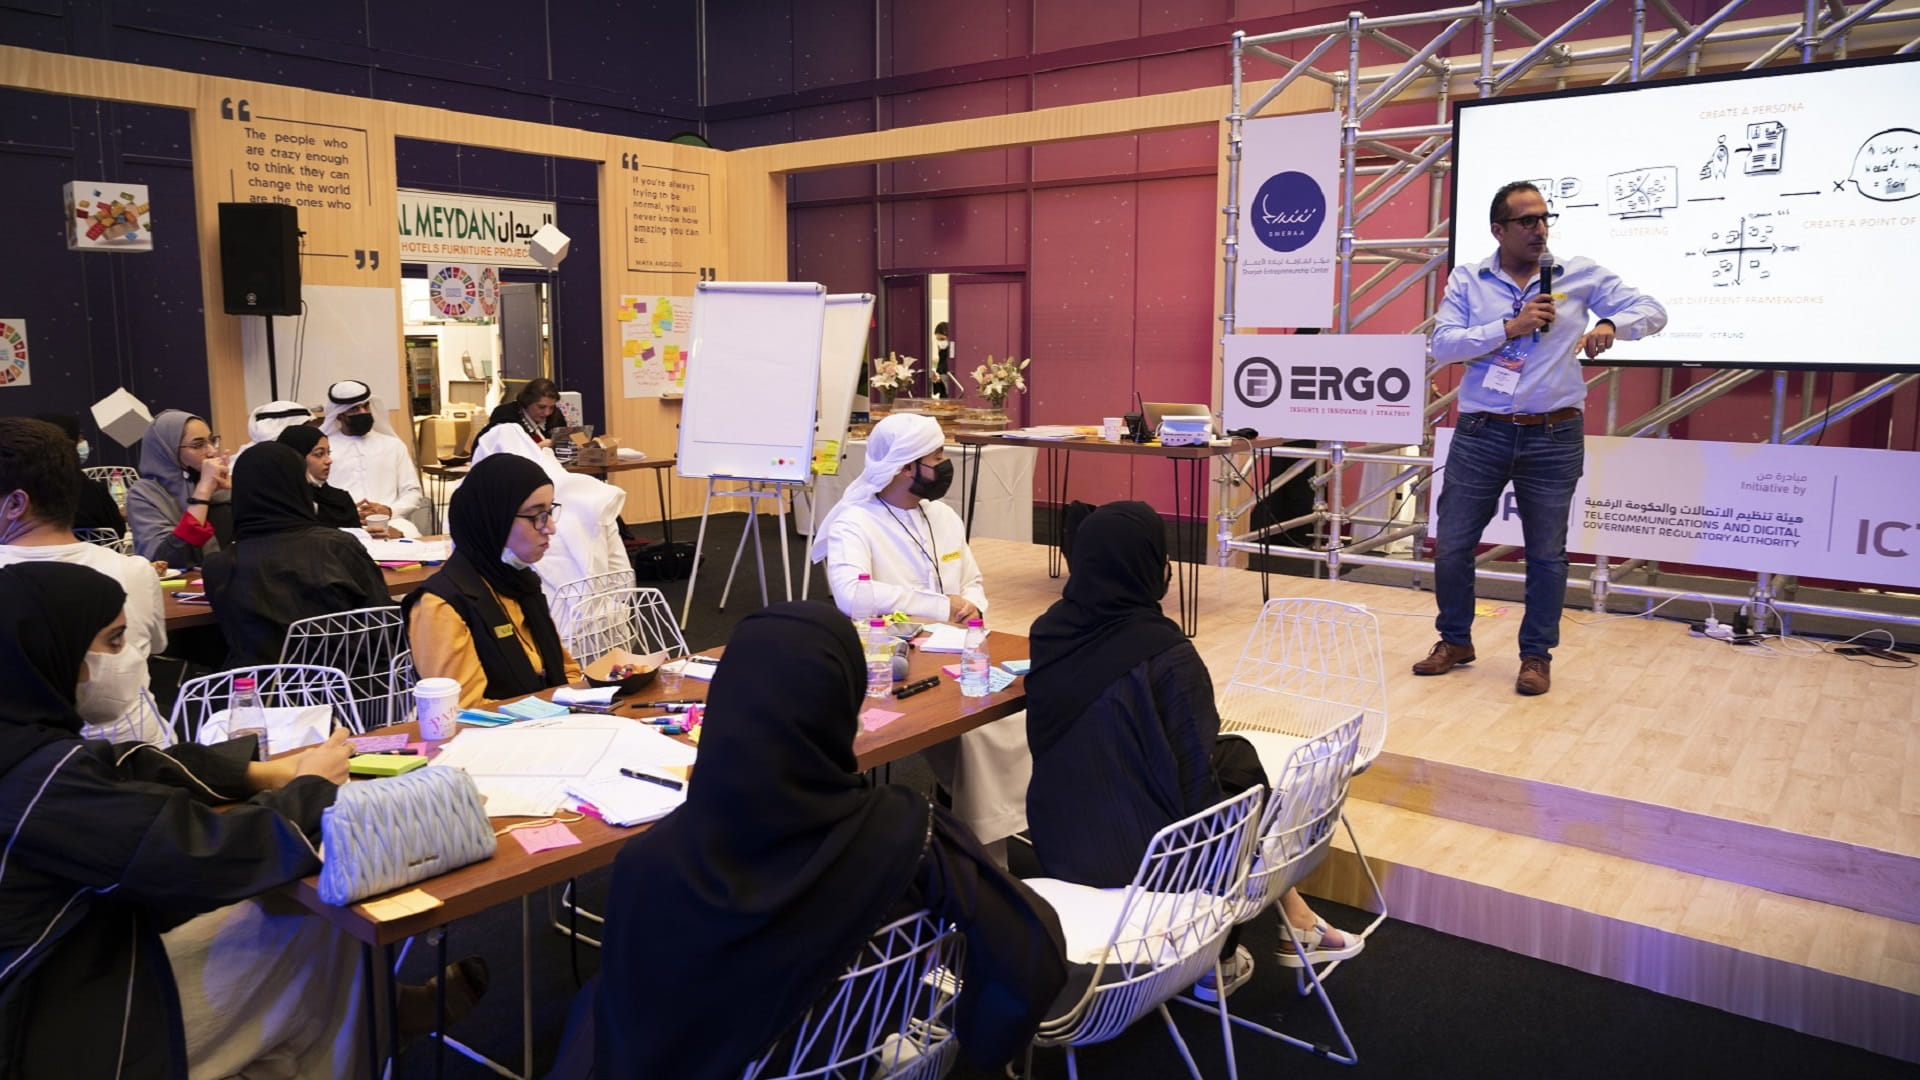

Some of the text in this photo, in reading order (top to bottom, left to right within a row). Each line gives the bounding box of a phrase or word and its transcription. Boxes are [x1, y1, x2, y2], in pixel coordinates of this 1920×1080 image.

[1700, 102, 1805, 119] CREATE A PERSONA
[245, 128, 348, 149] The people who
[246, 145, 349, 165] are crazy enough
[247, 161, 349, 180] to think they can
[248, 177, 350, 195] change the world
[669, 181, 695, 192] always
[250, 194, 351, 210] are the ones who
[633, 188, 680, 201] trying to be
[666, 204, 680, 213] you
[682, 205, 697, 214] will
[416, 203, 496, 241] MEYDAN
[634, 213, 699, 225] never know how
[1803, 216, 1917, 230] CREATE A POINT OF
[634, 225, 699, 236] amazing you can
[1610, 226, 1669, 239] CLUSTERING
[402, 242, 439, 254] HOTELS
[442, 244, 491, 257] FURNITURE
[1311, 266, 1329, 274] Center
[1686, 295, 1741, 305] DIFFERENT
[1744, 295, 1825, 305] FRAMEWORKS
[1290, 366, 1411, 402] ERGO
[1327, 407, 1367, 416] INNOVATION
[1375, 409, 1410, 417] STRATEGY
[1756, 472, 1807, 483] مبادرة من
[1740, 481, 1807, 496] Initiative by
[1584, 496, 1804, 525] هيئة تنظيم الاتصالات والحكومة الرقمية
[1584, 510, 1801, 538] TELECOMMUNICATIONS AND DIGITAL
[1583, 520, 1800, 548] GOVERNMENT REGULATORY AUTHORITY
